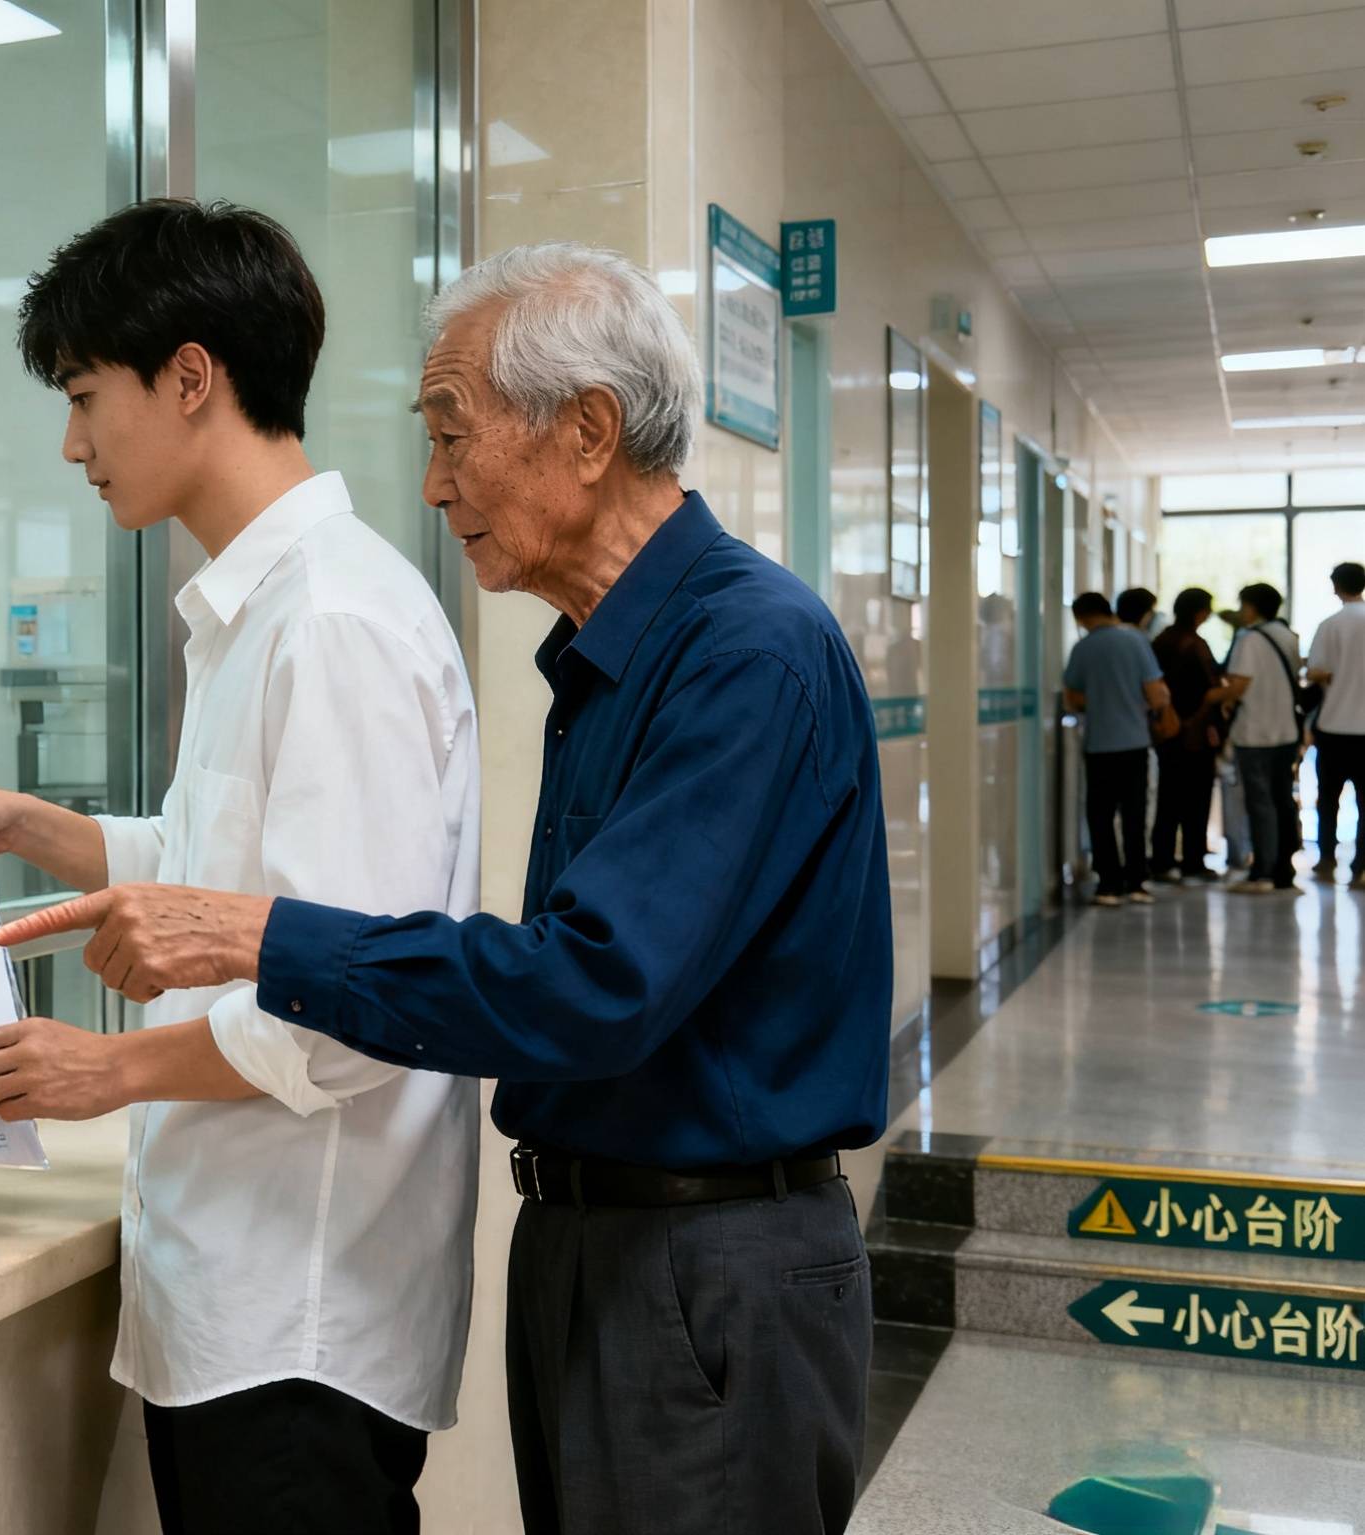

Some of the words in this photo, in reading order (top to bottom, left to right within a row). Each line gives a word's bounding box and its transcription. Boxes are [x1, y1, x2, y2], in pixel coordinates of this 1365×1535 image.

[1142, 1187, 1342, 1252] 小心台阶
[1173, 1294, 1364, 1361] 小心台阶
